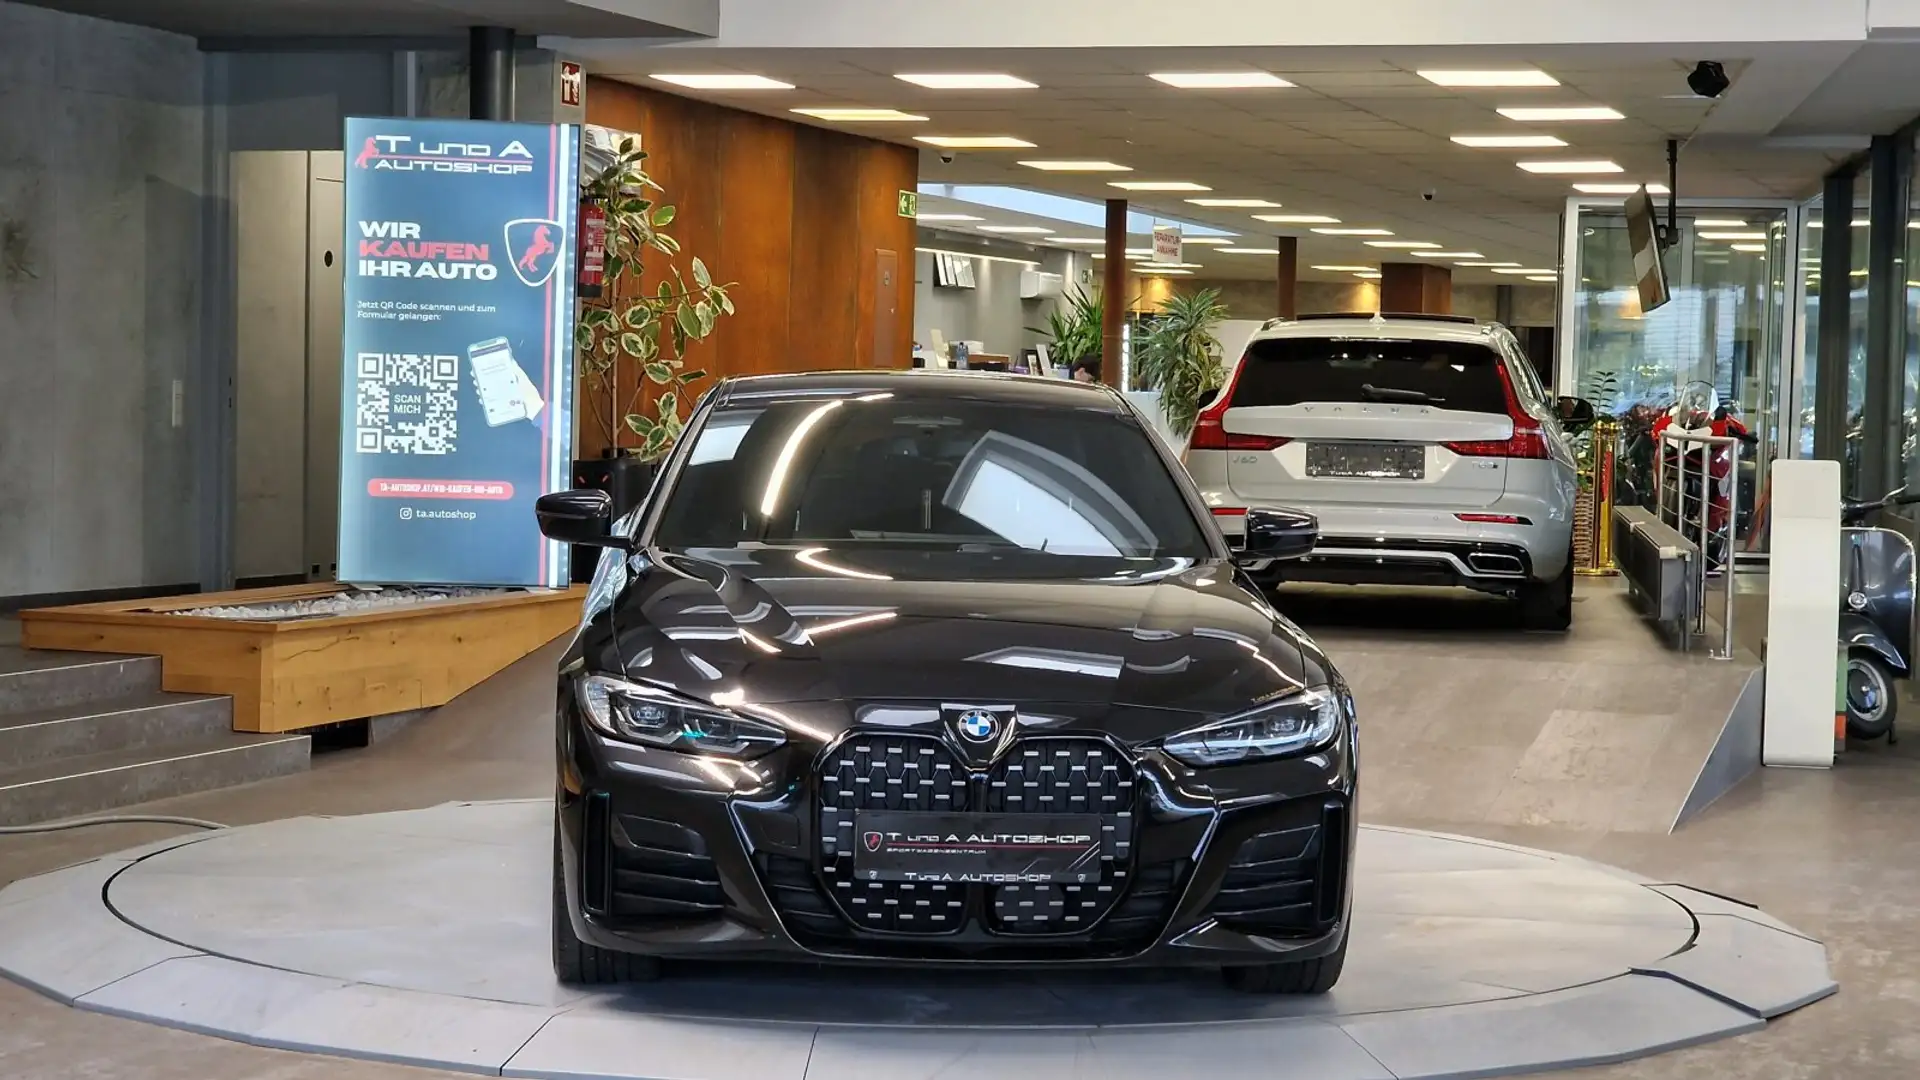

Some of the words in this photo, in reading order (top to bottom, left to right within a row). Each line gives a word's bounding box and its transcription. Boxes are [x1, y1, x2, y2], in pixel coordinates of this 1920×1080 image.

[375, 134, 412, 153] T
[498, 140, 534, 158] A
[374, 159, 533, 175] AUTOSHOP
[358, 220, 421, 239] WIR
[359, 239, 489, 261] KAUFEN
[358, 259, 412, 278] IHR
[414, 262, 498, 281] AUTO
[357, 300, 379, 309] Jetzt
[380, 301, 394, 309] QR
[395, 301, 419, 310] Code
[420, 302, 456, 311] scannen
[458, 303, 475, 312] und
[477, 304, 496, 312] zum
[357, 310, 397, 319] Formular
[398, 311, 441, 321] gelangen:
[394, 394, 422, 403] SCAN
[393, 404, 421, 414] MICH
[416, 508, 477, 520] ta.autoshop
[886, 832, 902, 841] T
[945, 833, 960, 842] A
[966, 833, 1091, 844] AUTOSHOP
[959, 872, 1052, 882] AUTOSHOP
